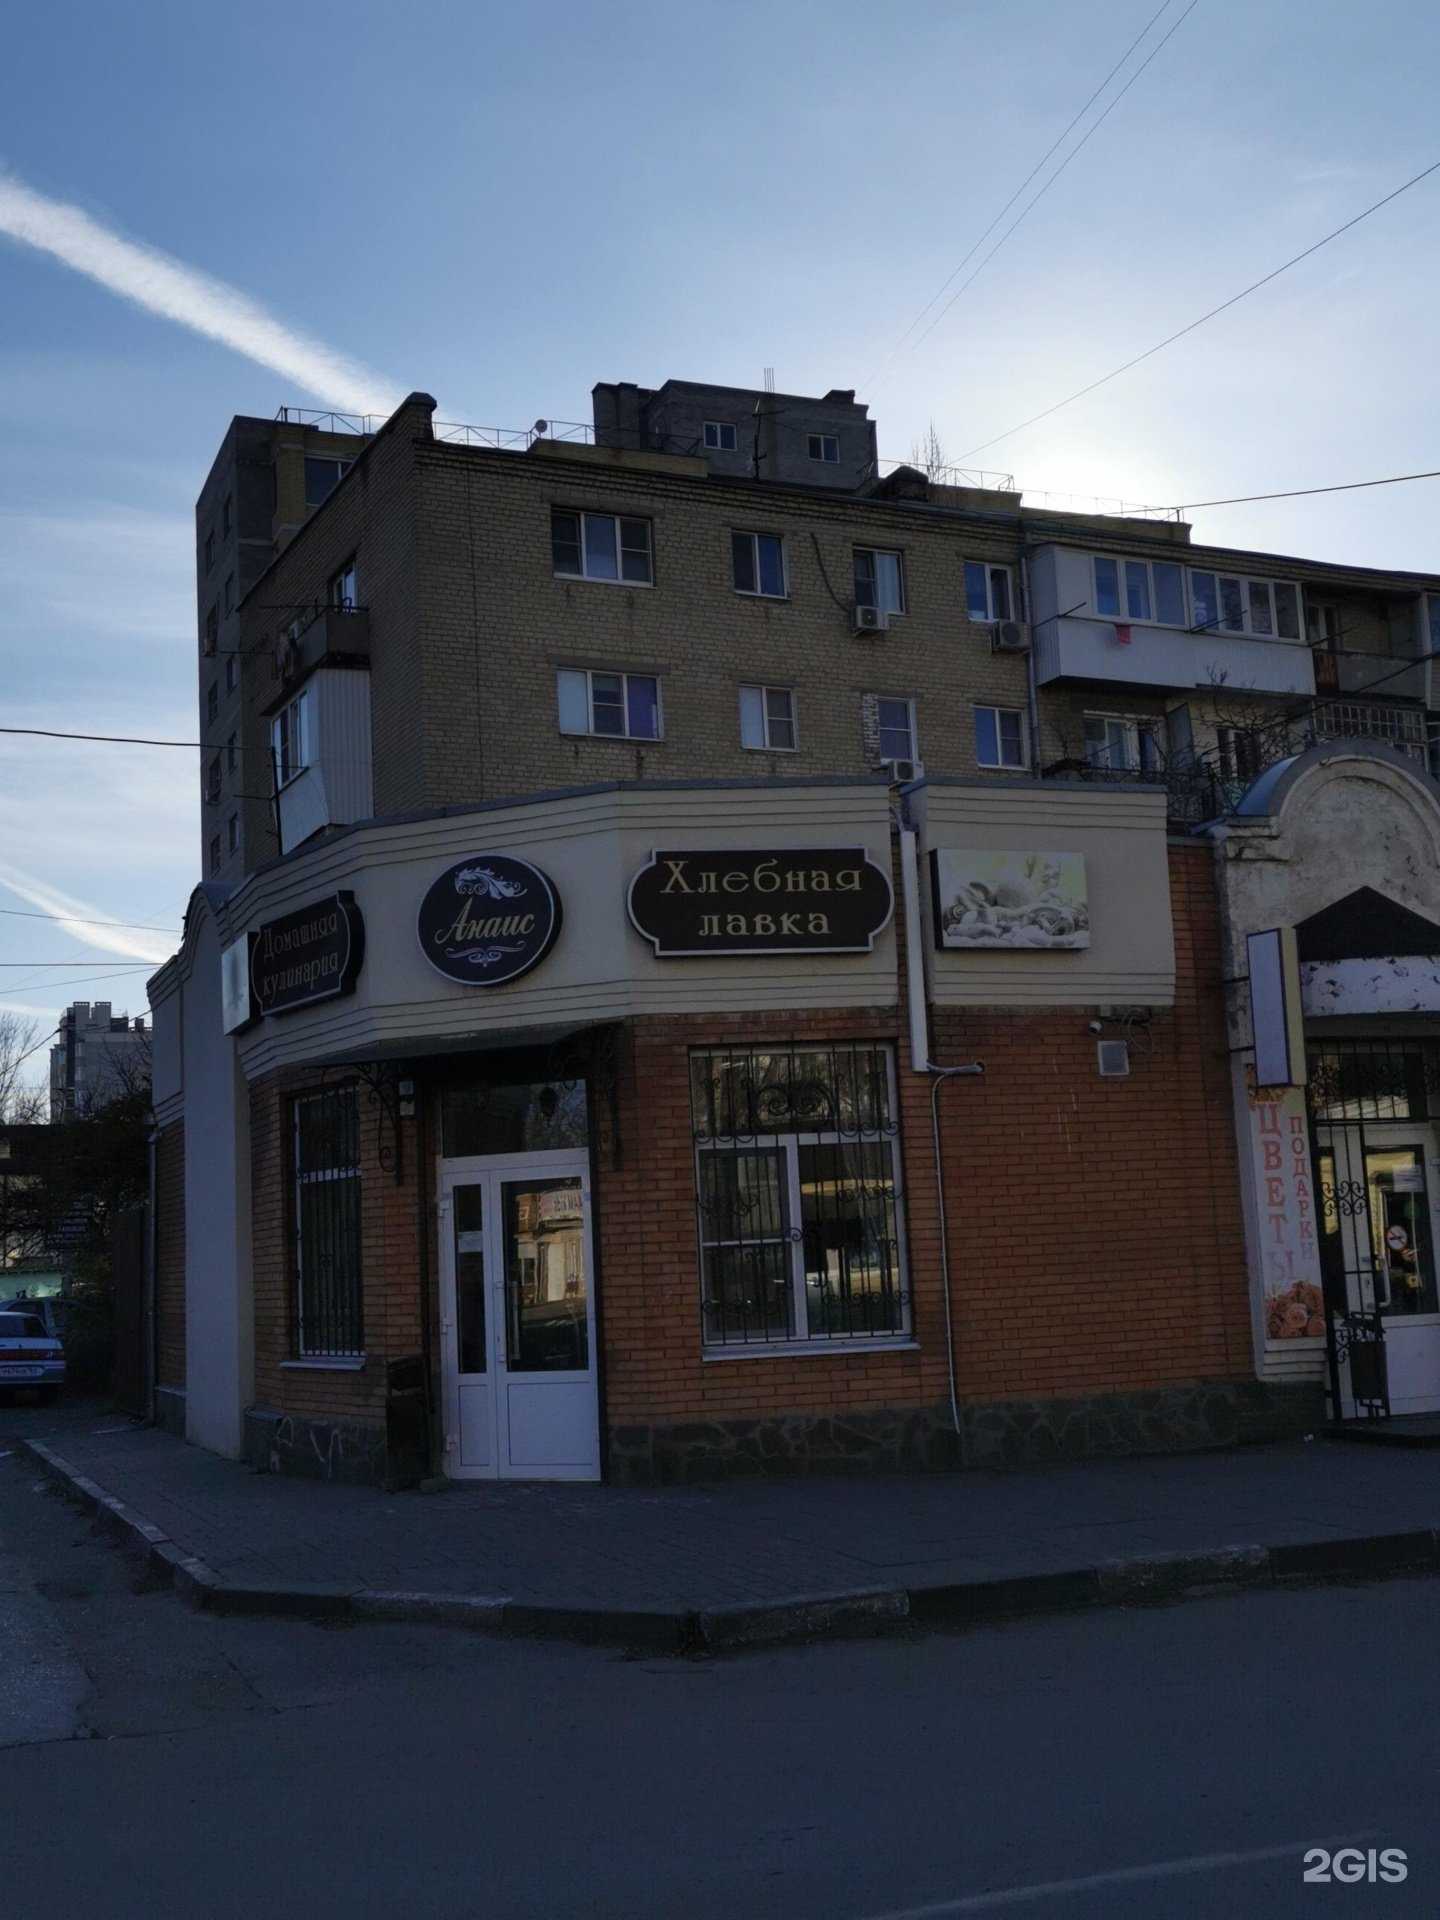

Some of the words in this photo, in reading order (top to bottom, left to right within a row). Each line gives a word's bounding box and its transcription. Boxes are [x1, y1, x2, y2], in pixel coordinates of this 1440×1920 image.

[659, 858, 863, 894] Хлебная
[263, 911, 338, 961] Домашняя
[434, 897, 536, 945] Анаис
[698, 911, 832, 937] лавка
[262, 951, 338, 1003] кулинария
[1258, 1104, 1296, 1280] ЦВЕТЫ
[1289, 1116, 1314, 1259] ПОДАРКИ
